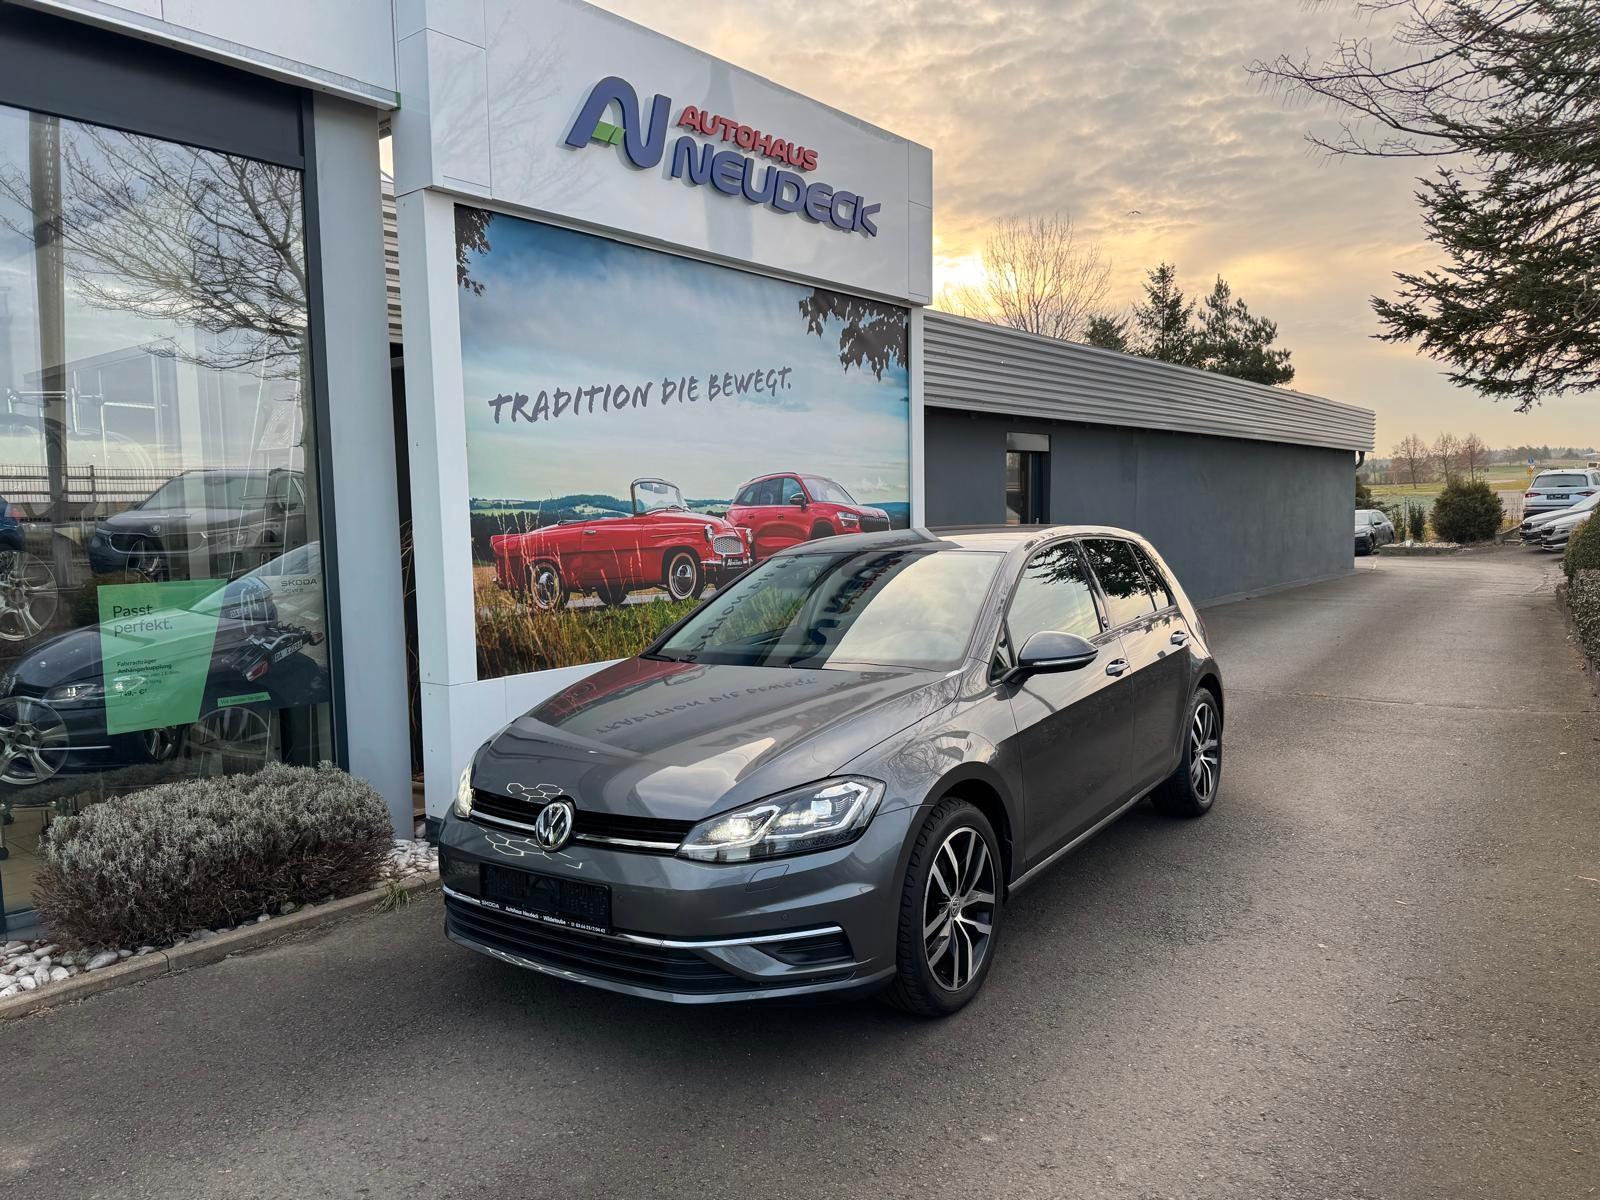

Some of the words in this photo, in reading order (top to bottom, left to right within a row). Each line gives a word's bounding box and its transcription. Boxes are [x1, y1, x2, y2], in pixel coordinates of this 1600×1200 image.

[677, 105, 819, 172] AUTOHAUS
[671, 136, 881, 237] NEUDECK
[488, 381, 653, 424] TRADITION
[661, 375, 699, 405] DIE
[708, 366, 793, 402] BEWEGT.
[112, 603, 153, 618] Passt
[114, 618, 173, 638] perfekt.
